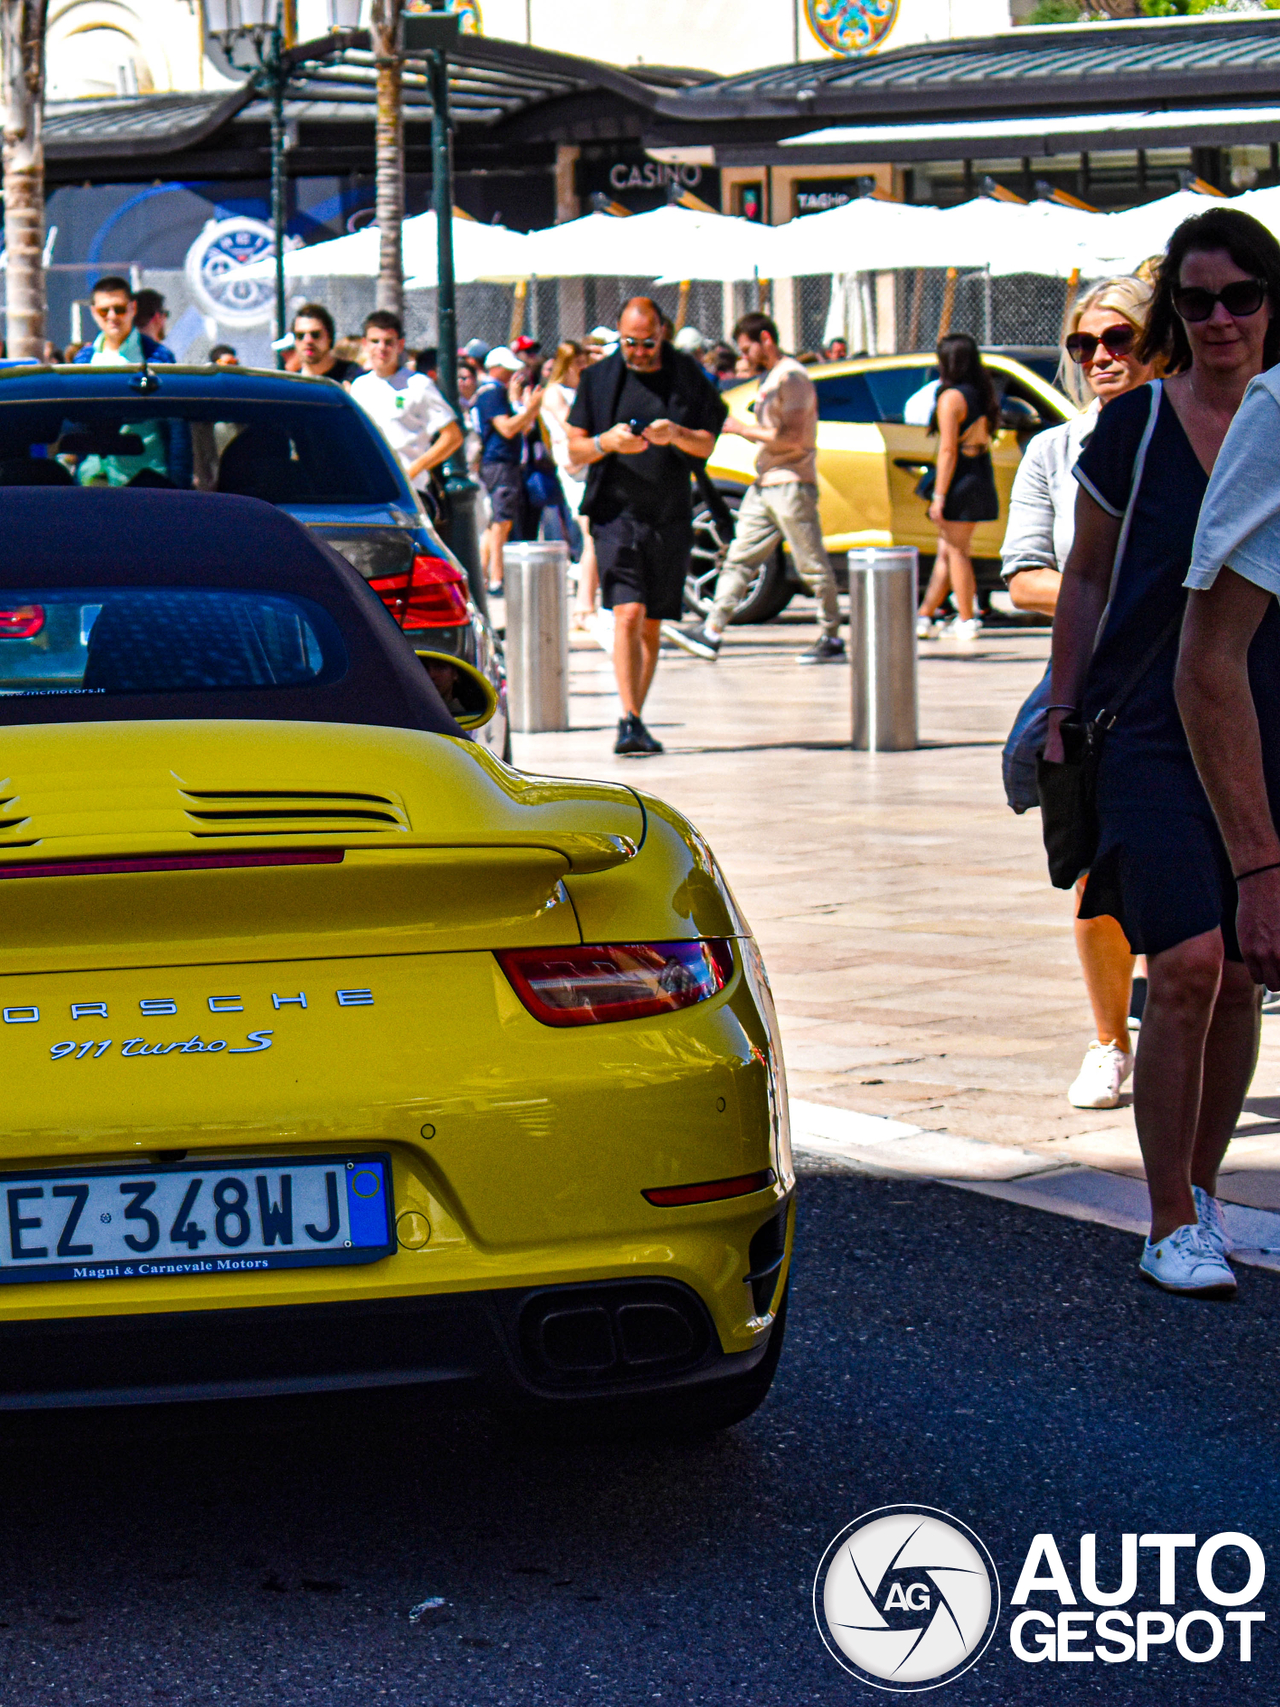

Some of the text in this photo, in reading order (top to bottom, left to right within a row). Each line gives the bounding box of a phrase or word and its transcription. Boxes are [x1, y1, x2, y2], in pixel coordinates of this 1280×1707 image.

[609, 163, 703, 189] CASINO
[50, 1029, 274, 1061] 911 turbo S
[6, 1171, 341, 1260] EZ 348WJ
[73, 1258, 269, 1279] Magni & Carnevale Motors
